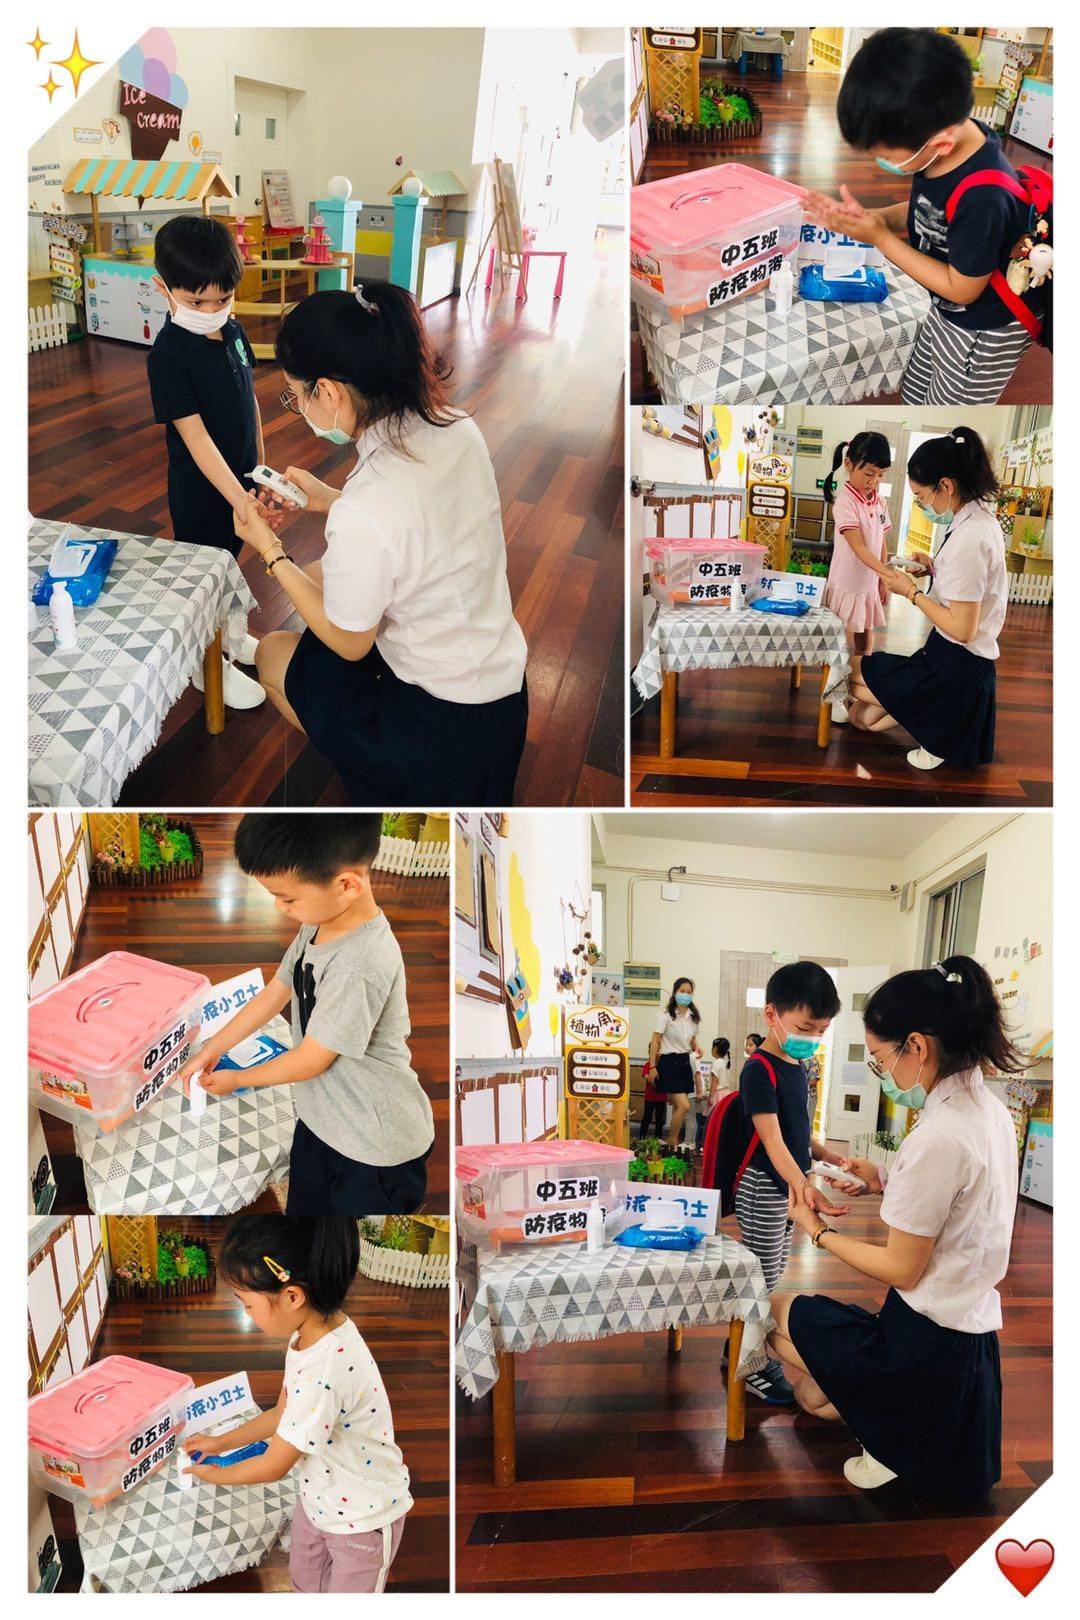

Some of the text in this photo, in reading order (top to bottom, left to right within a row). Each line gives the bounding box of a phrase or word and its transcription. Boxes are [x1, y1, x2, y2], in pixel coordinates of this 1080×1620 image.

[123, 84, 147, 105] Ice
[721, 229, 778, 267] 中五班
[698, 562, 741, 577] 中五班
[199, 984, 258, 1024] 疫小卫士
[570, 1011, 612, 1038] 植物角
[144, 1023, 186, 1070] 中五班
[135, 1043, 190, 1110] 防疫物资
[536, 1179, 598, 1202] 中五班
[130, 1416, 171, 1456] 中五班
[123, 1434, 176, 1490] 防疫物资
